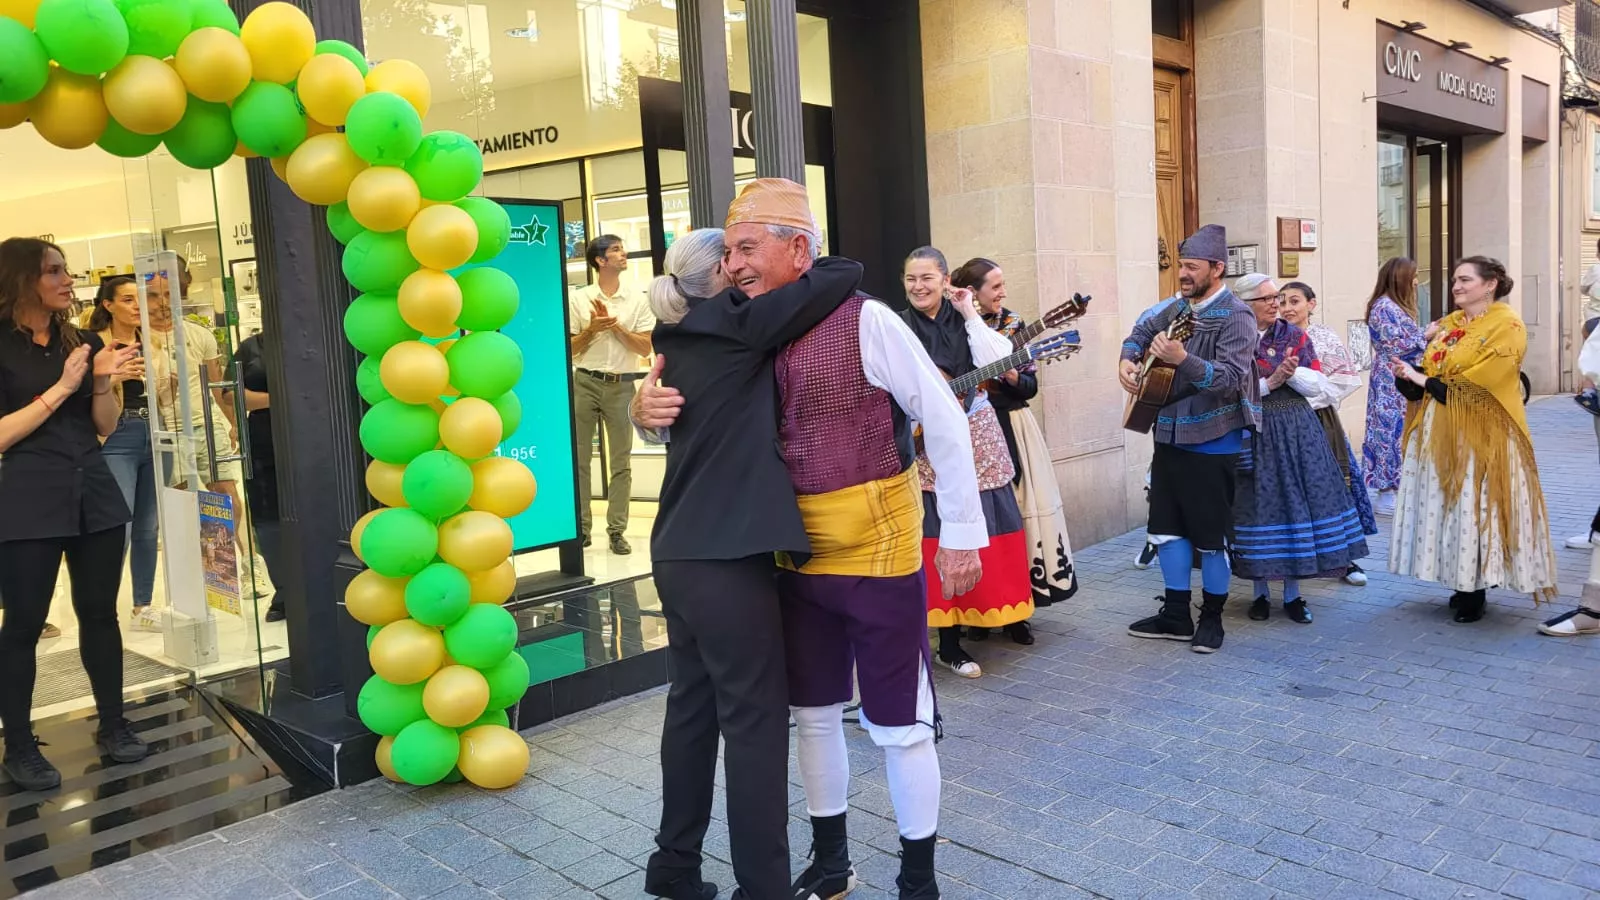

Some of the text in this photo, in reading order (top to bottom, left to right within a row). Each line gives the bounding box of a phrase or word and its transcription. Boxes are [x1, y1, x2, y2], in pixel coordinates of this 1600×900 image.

[1384, 41, 1421, 82] CMC
[1438, 71, 1497, 106] MODA HOGAR
